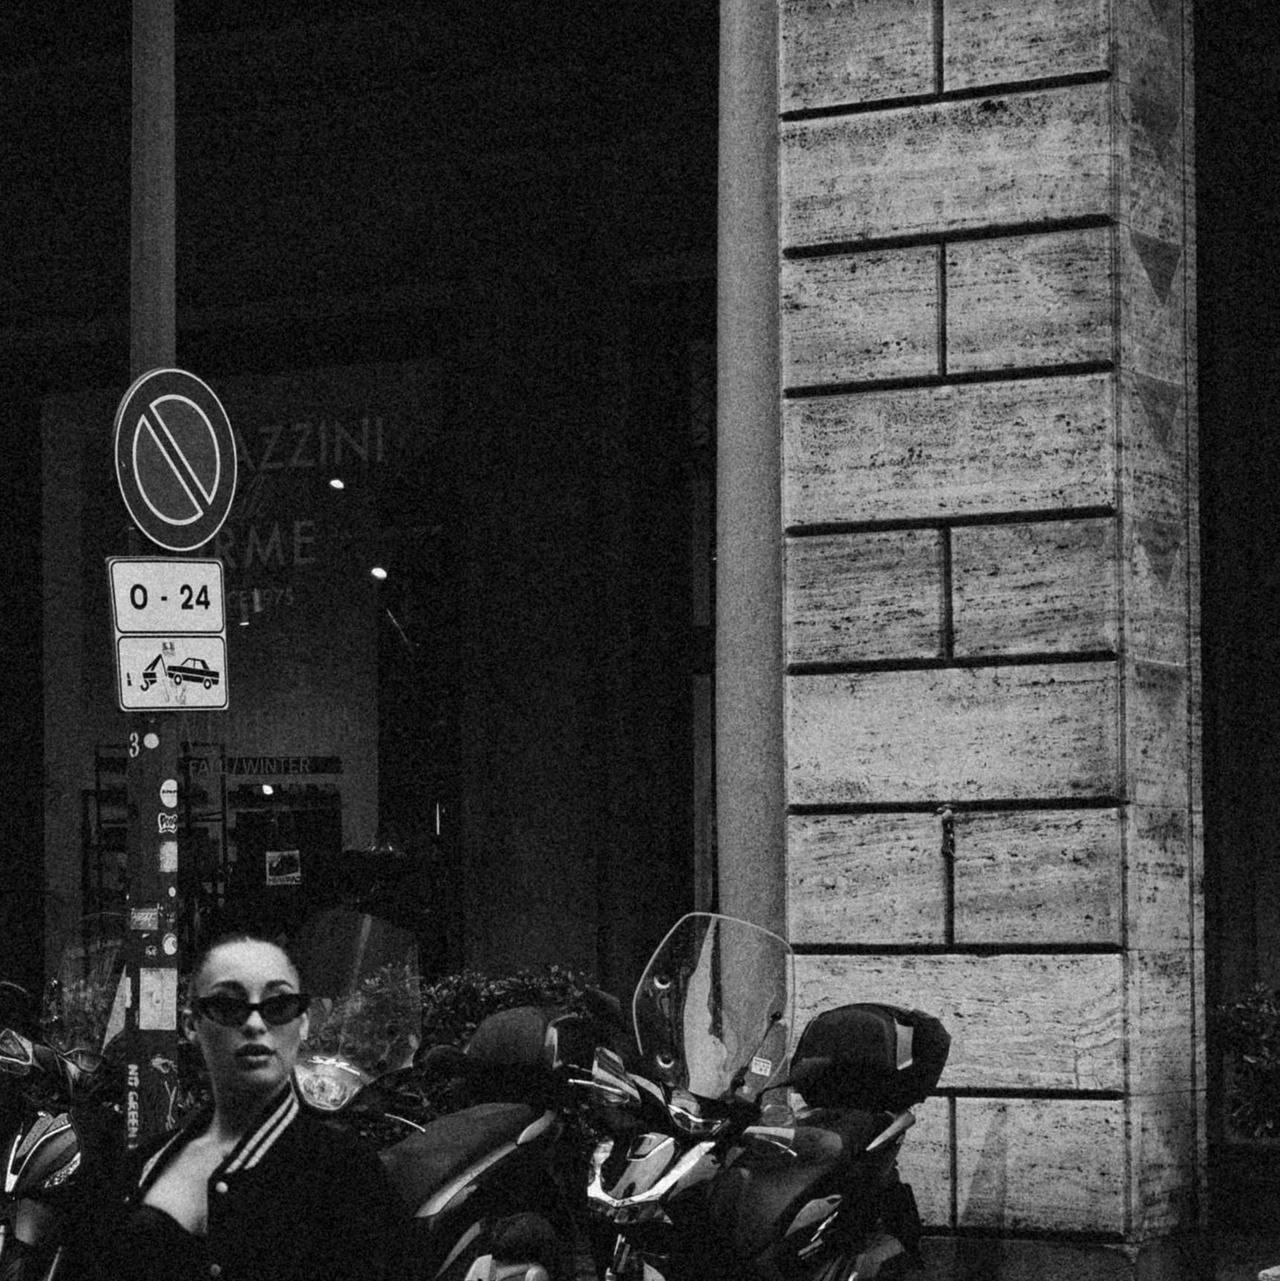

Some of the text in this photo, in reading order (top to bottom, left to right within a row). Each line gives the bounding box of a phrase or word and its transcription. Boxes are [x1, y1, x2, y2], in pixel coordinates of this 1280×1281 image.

[237, 417, 384, 471] AZZINI
[214, 520, 317, 569] RME
[179, 584, 210, 610] 24
[129, 732, 140, 758] 3
[127, 1091, 139, 1138] GREEN
